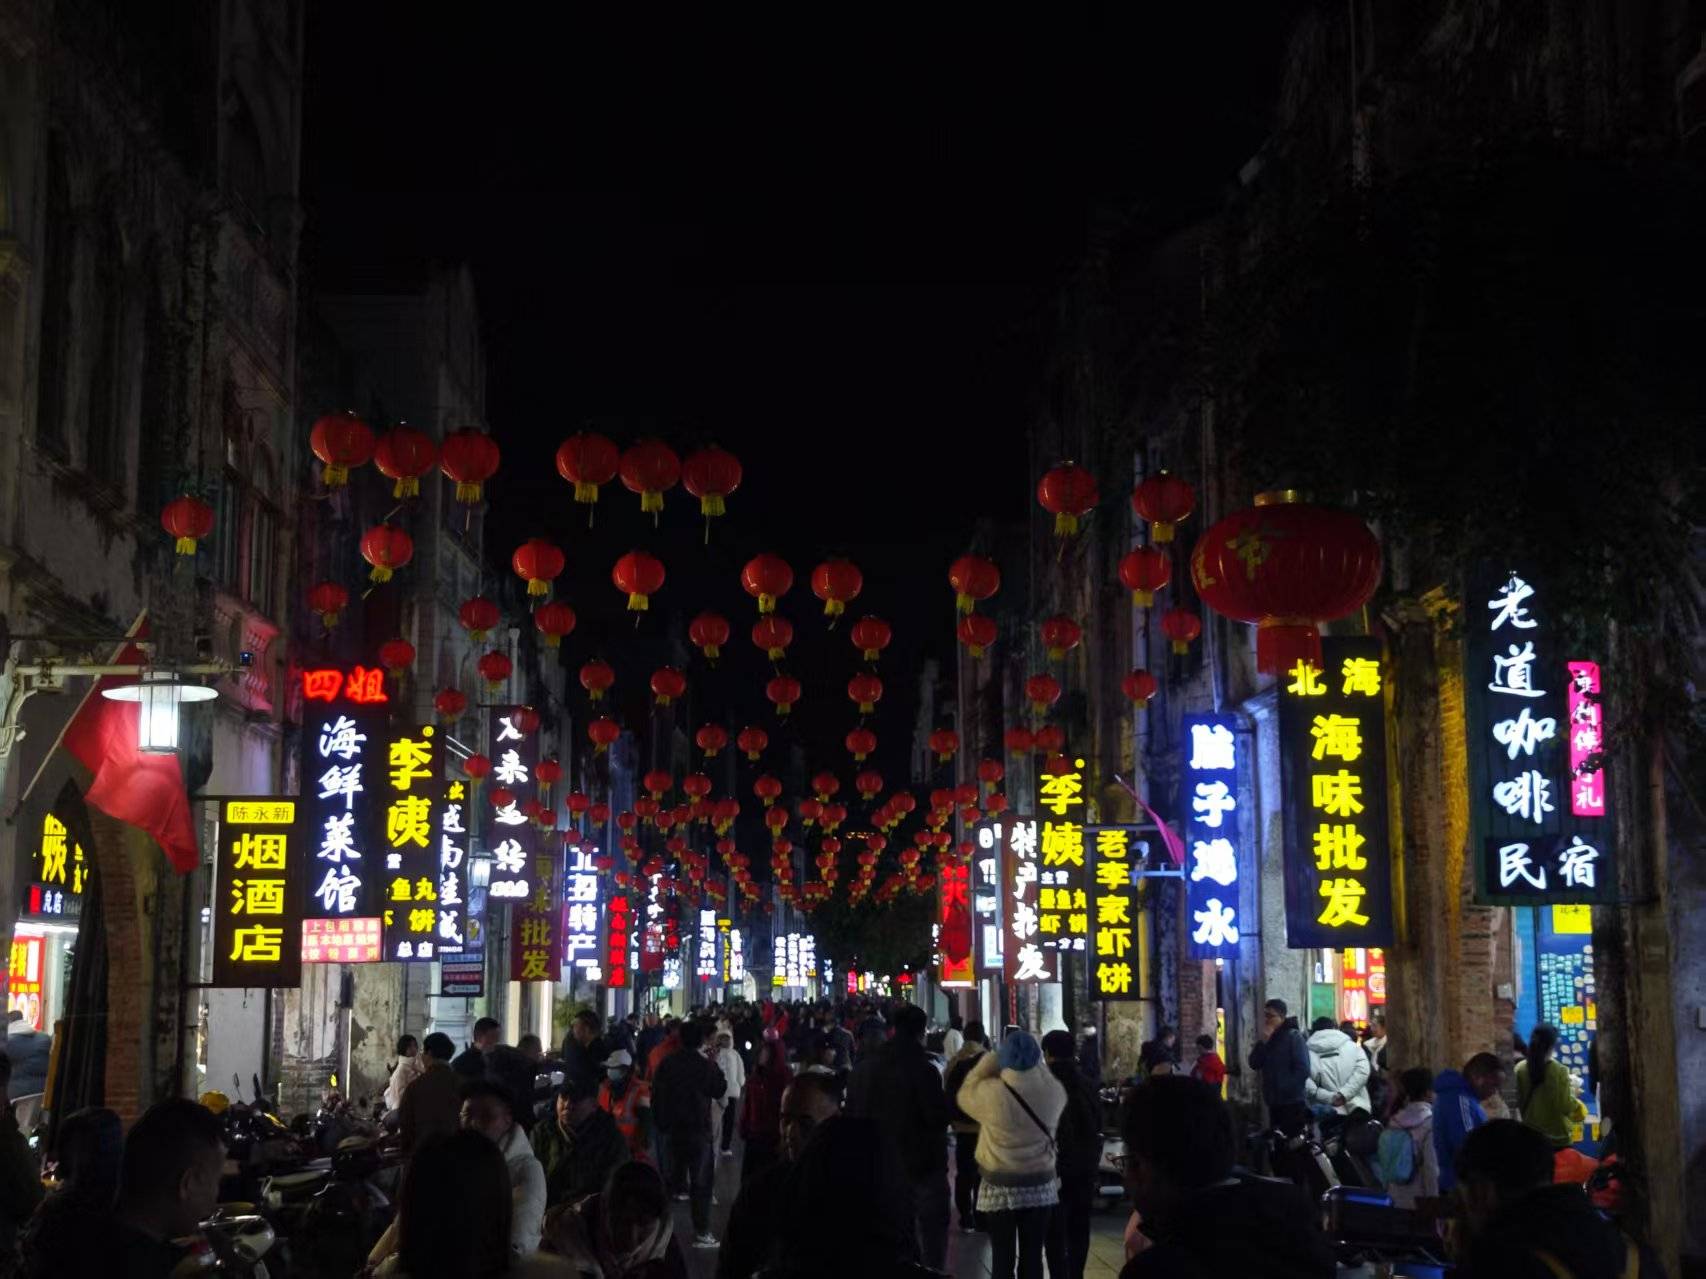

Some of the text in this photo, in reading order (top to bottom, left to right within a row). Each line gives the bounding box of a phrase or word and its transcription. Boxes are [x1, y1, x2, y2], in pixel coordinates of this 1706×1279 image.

[303, 666, 387, 703] 四姐
[1288, 658, 1381, 696] 北海
[1488, 571, 1556, 824] 老道咖啡
[232, 806, 289, 820] 陈永新
[315, 716, 366, 913] 海鲜菜馆
[1040, 773, 1084, 866] 李姨
[1310, 714, 1369, 927] 海味批发
[230, 833, 286, 961] 烟酒店
[387, 877, 437, 900] 鱼丸
[1499, 836, 1599, 889] 民宿
[1094, 828, 1136, 993] 老李家虾饼
